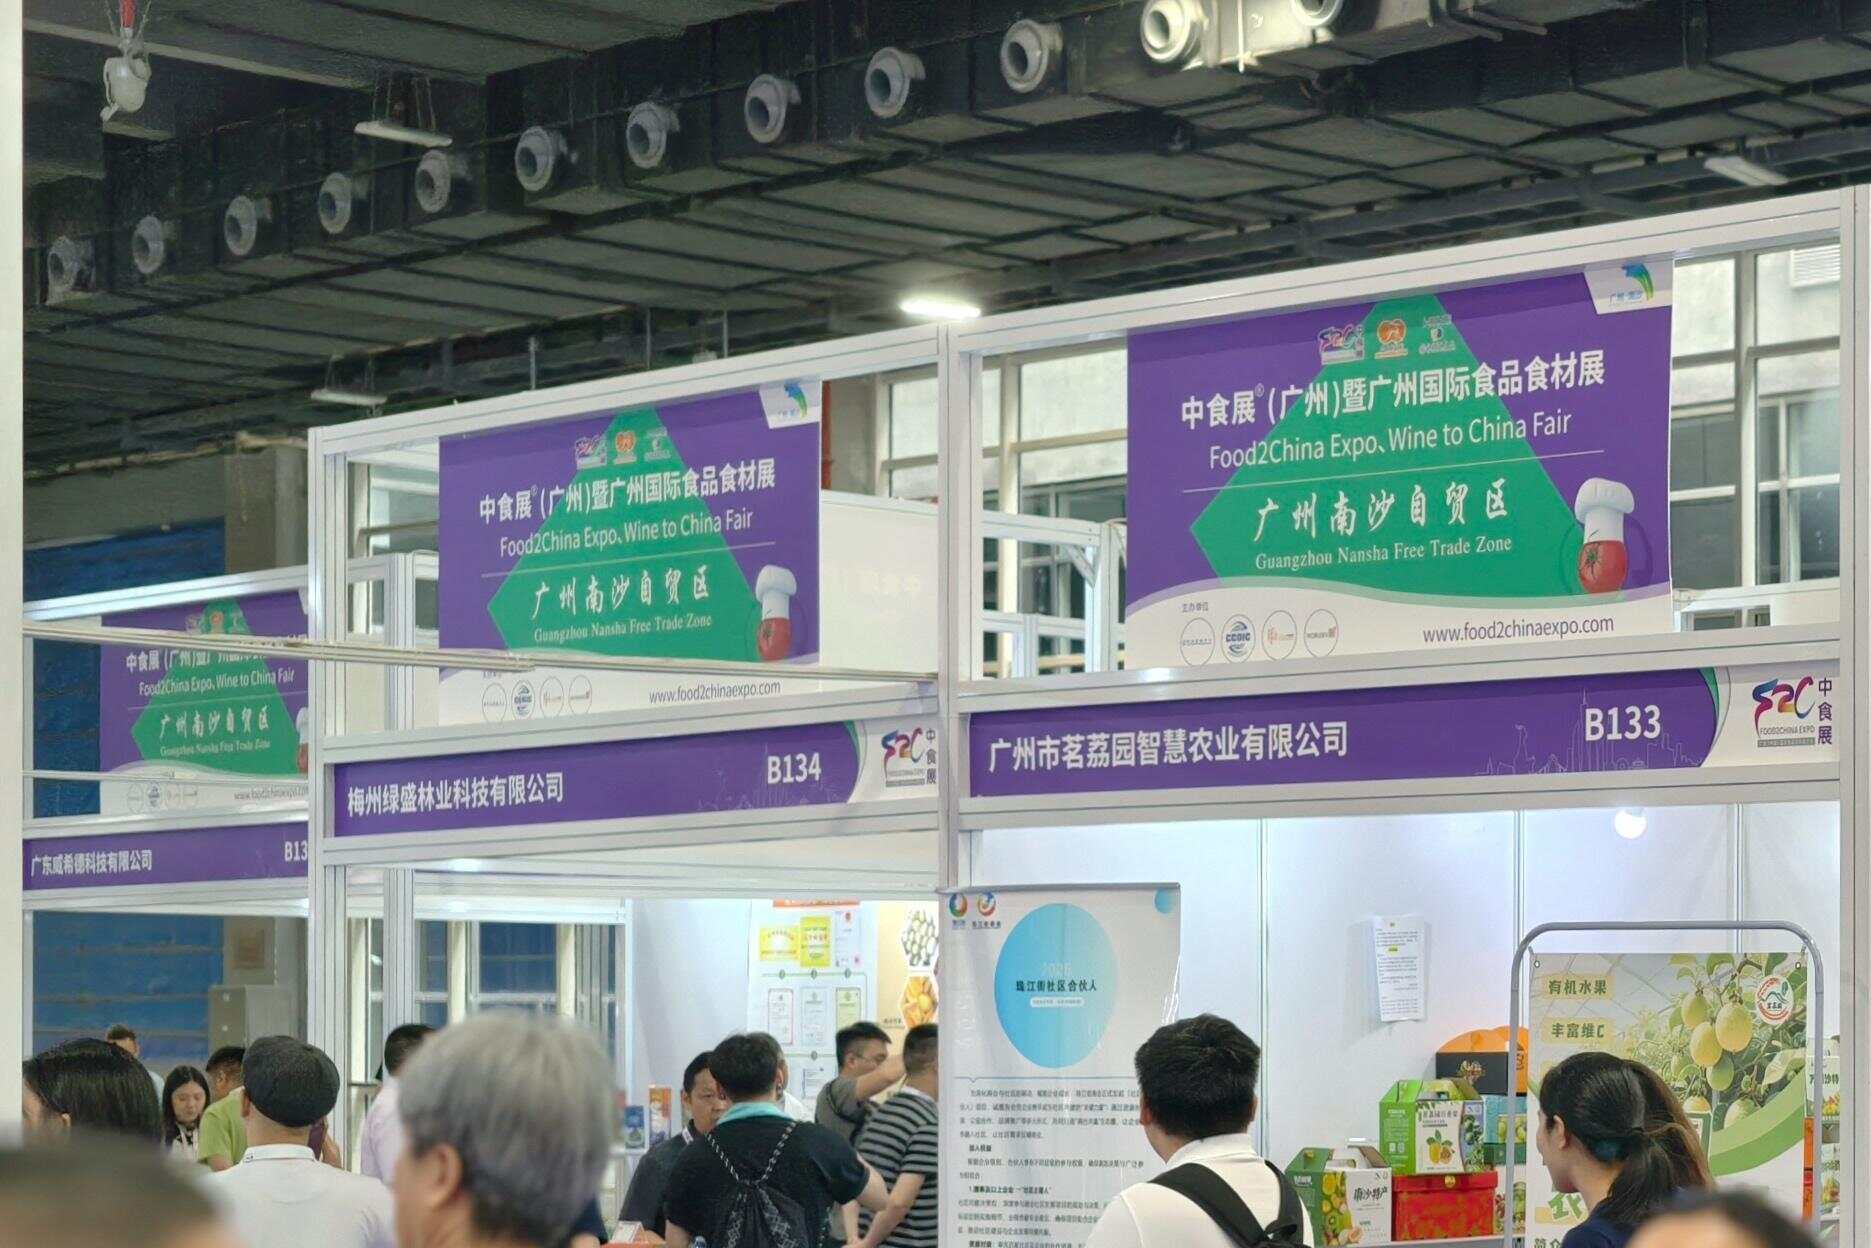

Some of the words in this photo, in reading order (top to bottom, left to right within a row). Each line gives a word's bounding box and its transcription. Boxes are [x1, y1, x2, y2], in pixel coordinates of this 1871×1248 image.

[1209, 429, 1325, 469] Food2China
[1387, 418, 1438, 452] Wine
[1443, 419, 1464, 445] to
[1469, 410, 1527, 444] China
[1532, 406, 1572, 438] Fair
[1253, 478, 1510, 542] 广州南沙自贸区
[500, 527, 582, 558] Food2China
[624, 519, 660, 543] Wine
[662, 518, 678, 537] to
[680, 512, 721, 537] China
[725, 507, 753, 531] Fair
[1255, 545, 1334, 573] Guangzhou
[1337, 542, 1390, 565] Nansha
[1393, 539, 1426, 560] Free
[1430, 536, 1472, 558] Trade
[1475, 534, 1513, 554] Zone
[532, 565, 710, 620] 广州南沙自贸区
[534, 623, 589, 643] Guangzhou
[591, 620, 627, 636] Nansha
[629, 618, 652, 634] Free
[654, 616, 684, 631] Trade
[686, 614, 713, 629] Zone
[1423, 615, 1615, 645] www.food2chinaexpo.com
[649, 680, 781, 705] www.food2chinaexpo.com
[1817, 676, 1833, 745] 中食展
[159, 704, 270, 740] 广州南沙自贸区
[1584, 704, 1661, 742] B133
[989, 720, 1348, 773] 广州市茗荔园智慧农业有限公司
[766, 751, 822, 785] B134
[347, 772, 563, 818] 梅州绿盛林业科技有限公司
[284, 840, 308, 862] B13
[1548, 979, 1607, 995] 有机水果
[1551, 1022, 1605, 1039] 丰富维C
